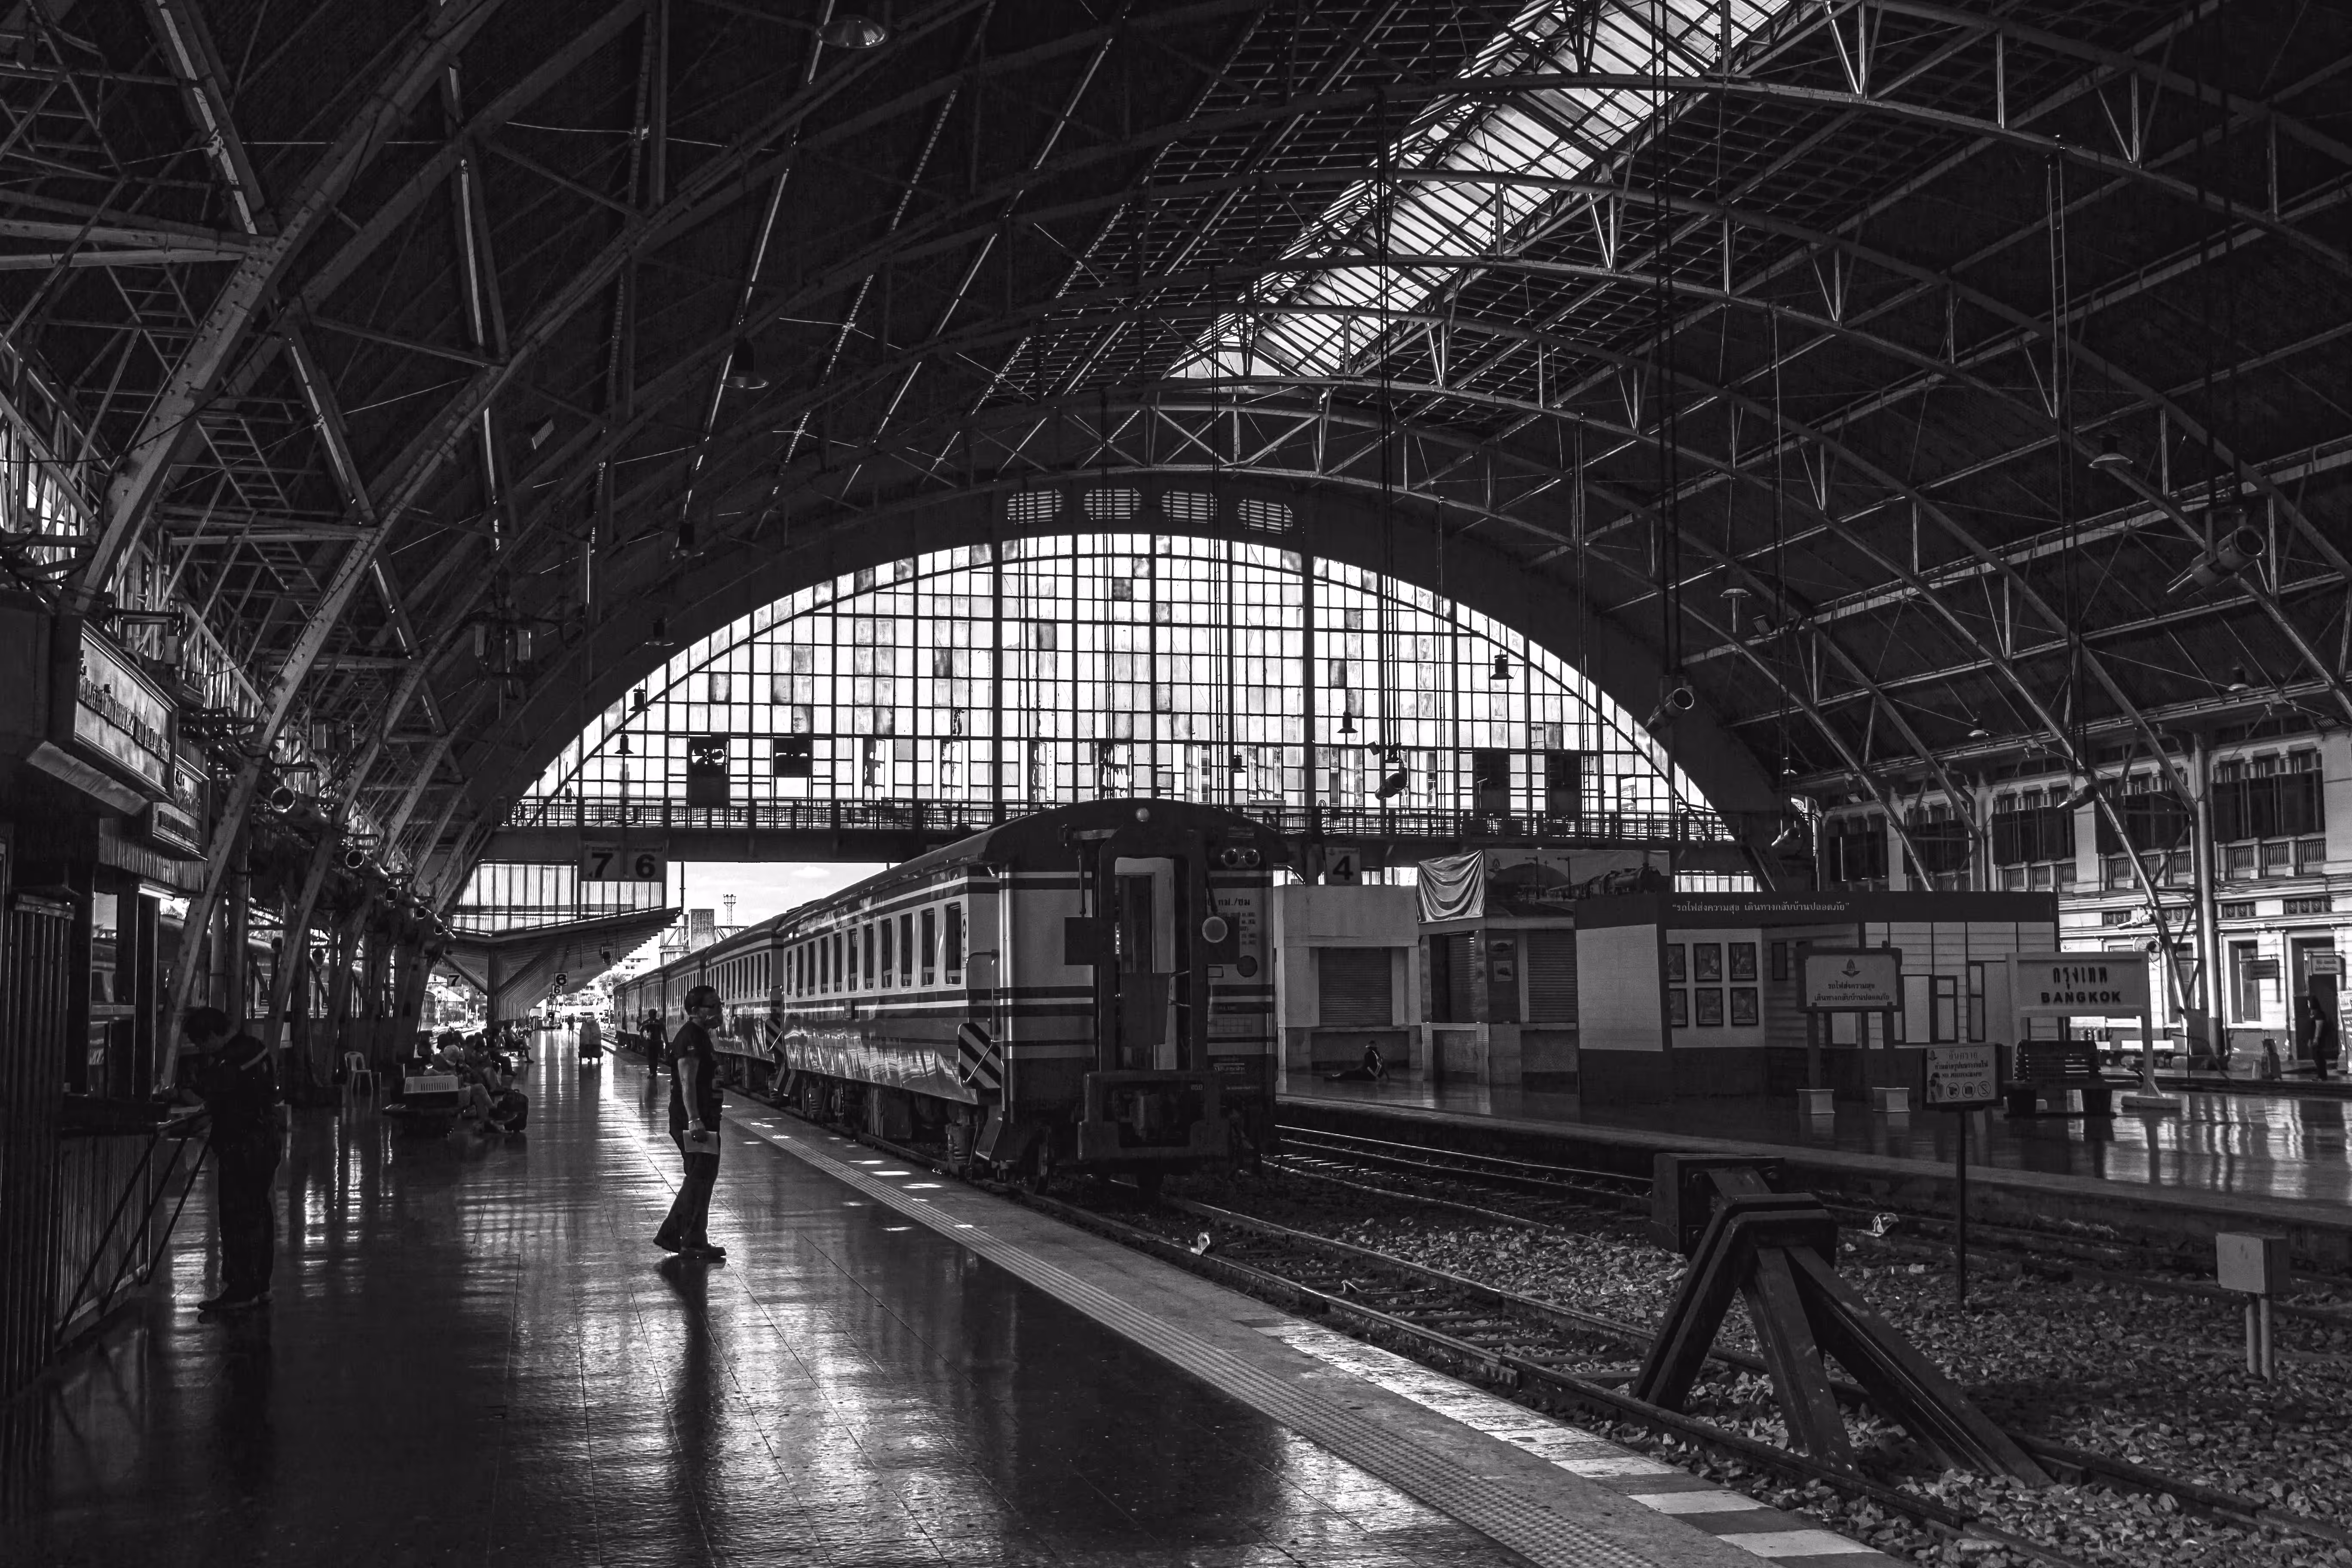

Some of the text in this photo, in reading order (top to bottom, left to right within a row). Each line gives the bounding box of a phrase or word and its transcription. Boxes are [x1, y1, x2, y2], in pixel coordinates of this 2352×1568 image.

[592, 853, 613, 878] 7
[636, 854, 655, 879] 6
[1333, 856, 1354, 880] 4
[448, 975, 460, 986] 7
[556, 974, 567, 985] 6
[2052, 967, 2108, 989] กรุงเทพ
[2040, 991, 2121, 1004] BANGKOK
